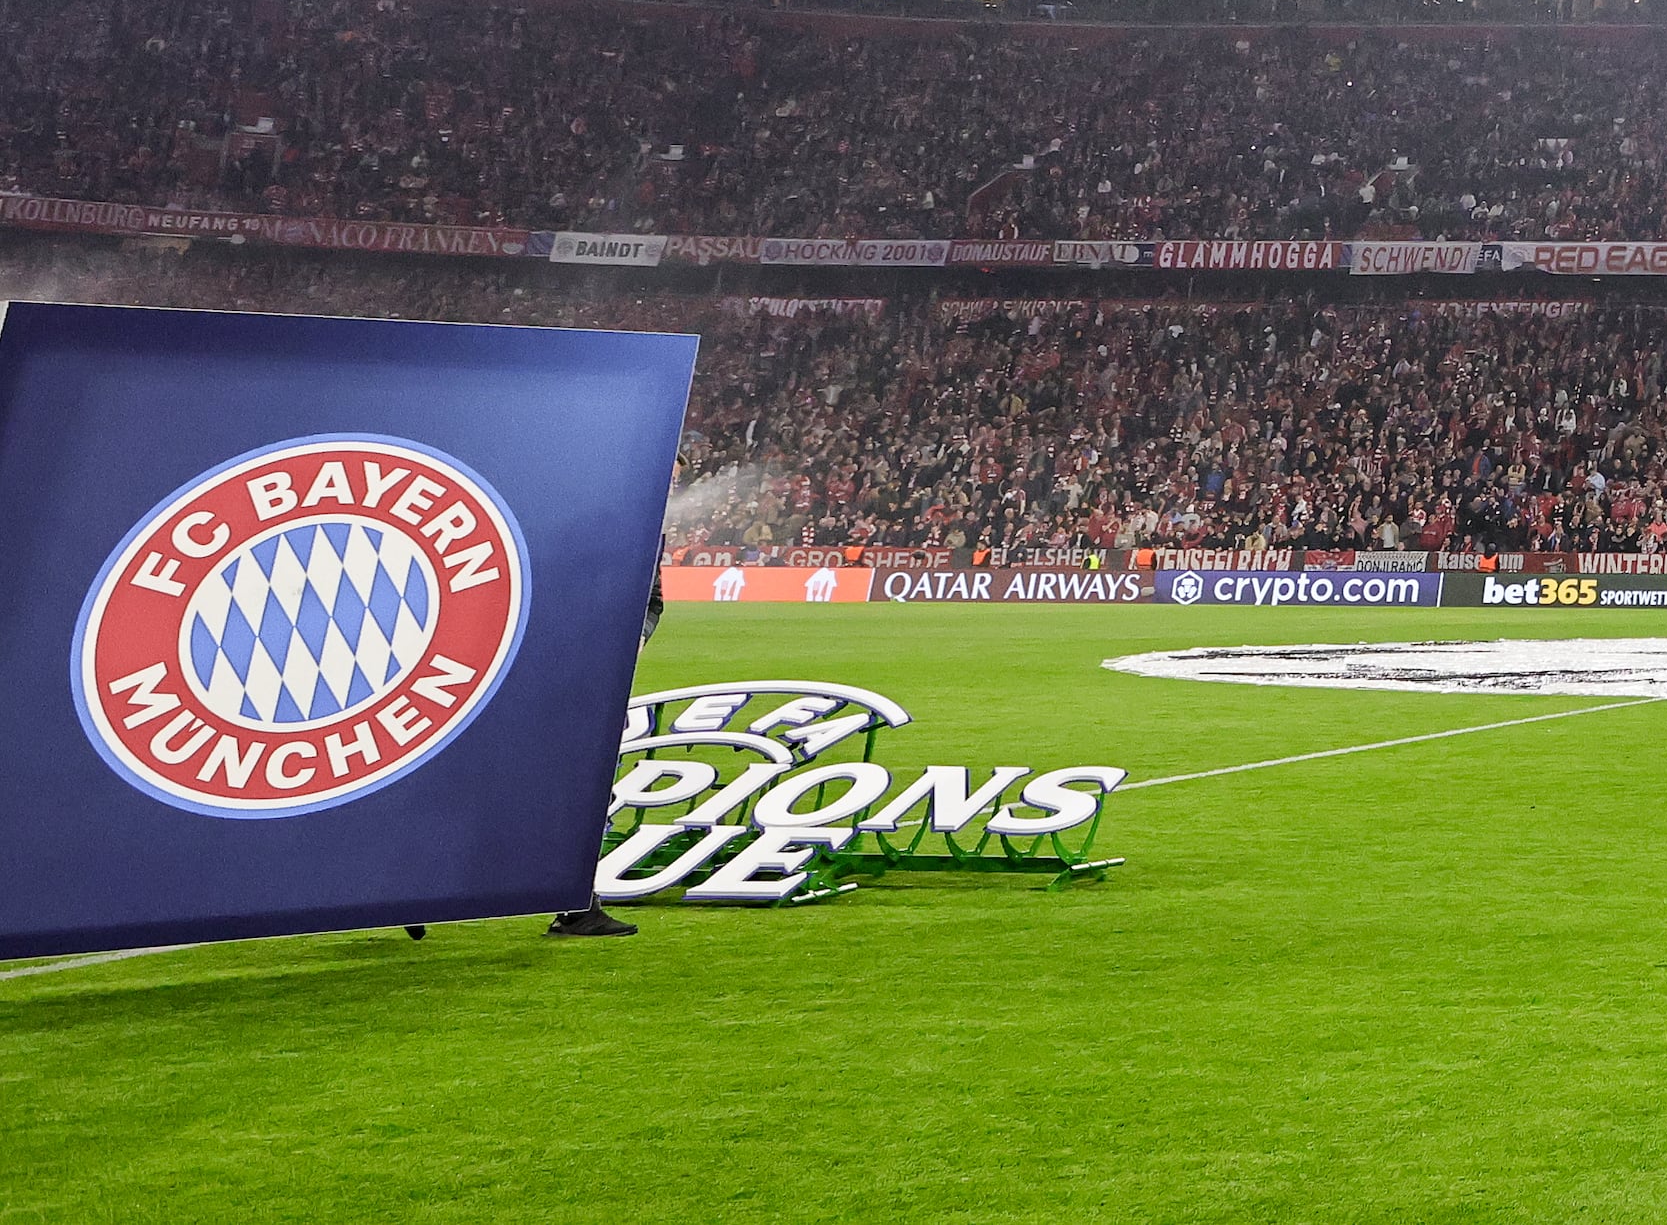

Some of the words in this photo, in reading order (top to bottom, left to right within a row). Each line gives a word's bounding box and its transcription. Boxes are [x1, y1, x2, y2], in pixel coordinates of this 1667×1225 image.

[148, 216, 239, 231] NEUFANG
[576, 240, 644, 259] BAINDT
[664, 237, 762, 261] PASSAU
[784, 242, 877, 261] HOCKING
[881, 242, 927, 261] 2001
[1159, 242, 1333, 269] GLAMMHOGGA
[1359, 245, 1471, 272] SCHWENDI
[1535, 246, 1598, 271] RED
[130, 510, 232, 598] FC
[246, 461, 500, 594] BAYERN
[884, 571, 992, 602] QATAR
[1003, 572, 1141, 601] AIRWAYS
[1214, 572, 1420, 606] crypto.com
[1483, 578, 1598, 605] bet365
[110, 653, 478, 790] MÜNCHEN
